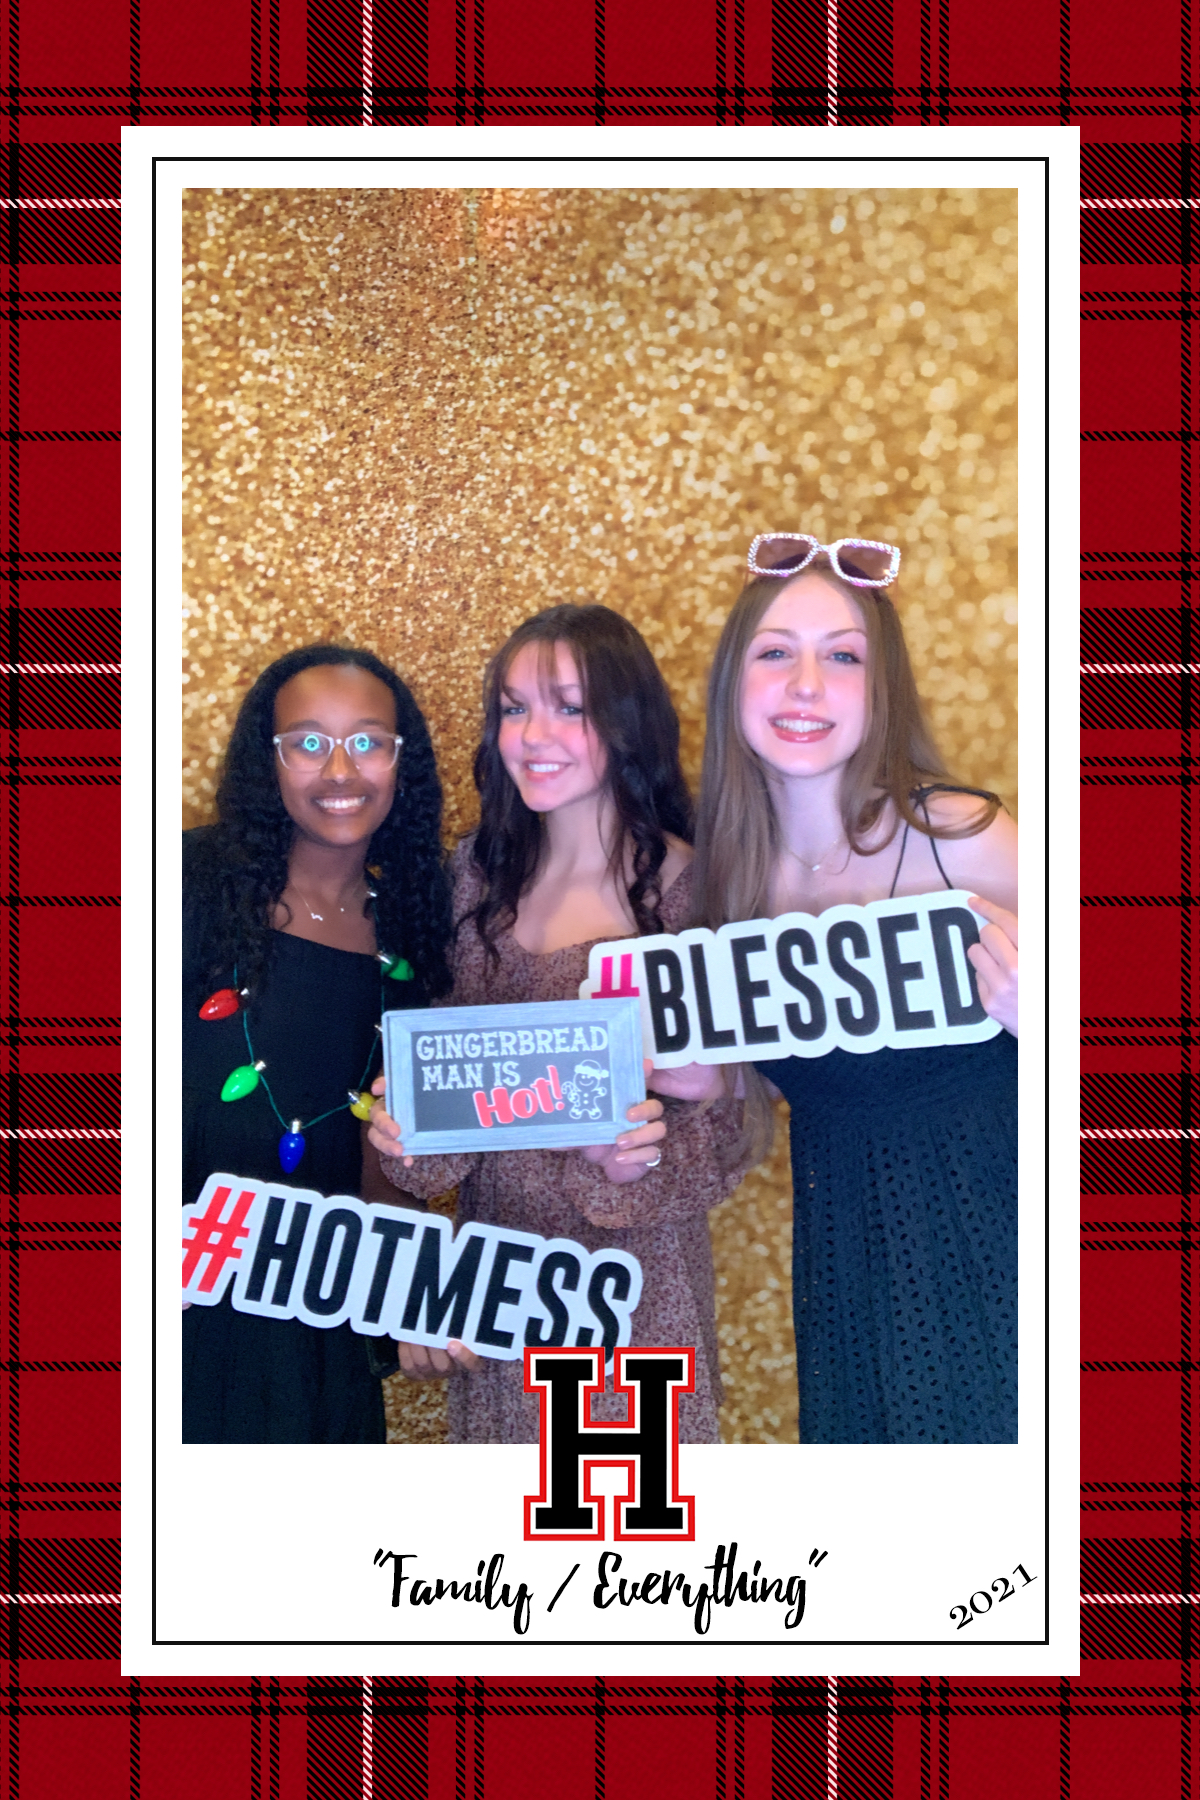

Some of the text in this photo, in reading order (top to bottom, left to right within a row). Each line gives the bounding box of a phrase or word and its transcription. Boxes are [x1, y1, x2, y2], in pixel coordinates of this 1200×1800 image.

[416, 1026, 609, 1061] GINGERBREAD
[422, 1060, 521, 1091] MAN IS
[473, 1064, 565, 1128] Hot!
[182, 1185, 632, 1364] #HOTMESS
